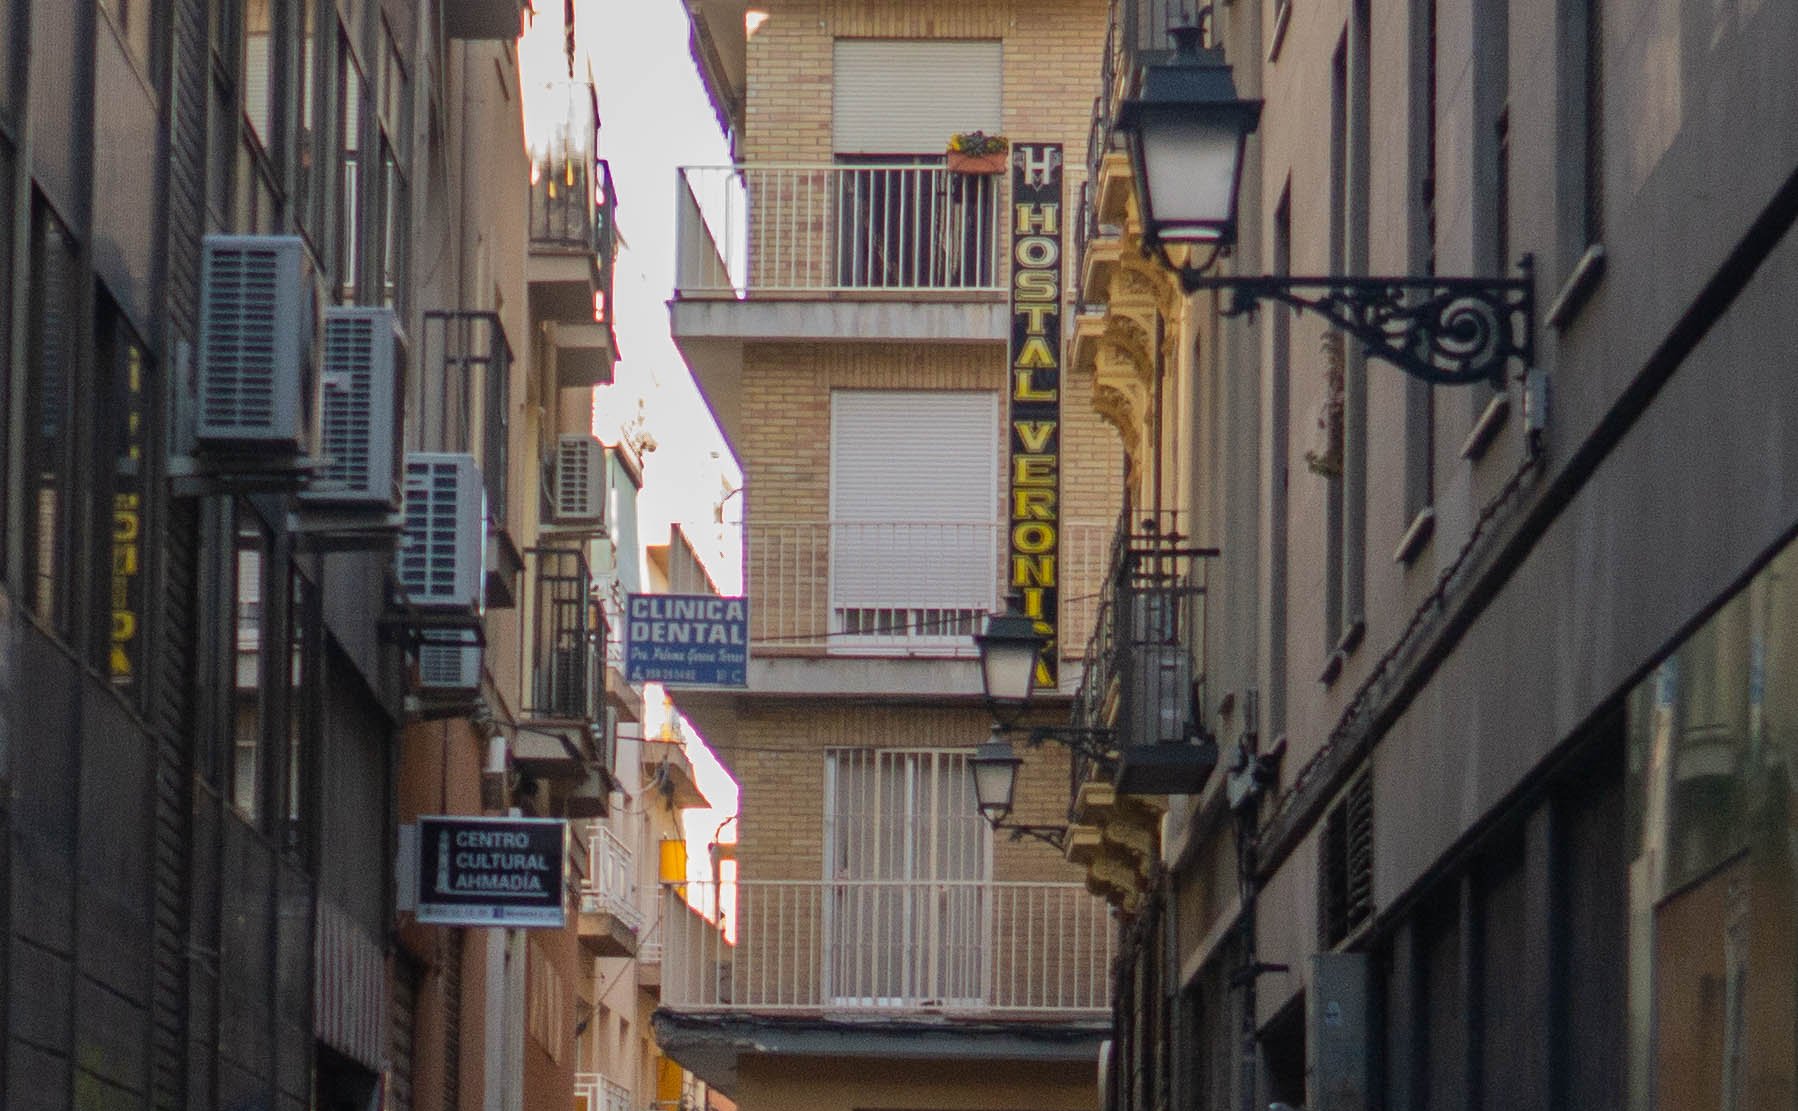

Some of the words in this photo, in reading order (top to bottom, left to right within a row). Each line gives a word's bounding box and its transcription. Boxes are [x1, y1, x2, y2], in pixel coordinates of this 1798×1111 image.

[1014, 203, 1058, 401] HOSTAL
[632, 598, 744, 621] CLINICA
[631, 621, 744, 645] DENTAL
[455, 831, 530, 848] CENTRO
[455, 852, 549, 871] CULTURAL
[455, 872, 542, 891] AHMADÍA
